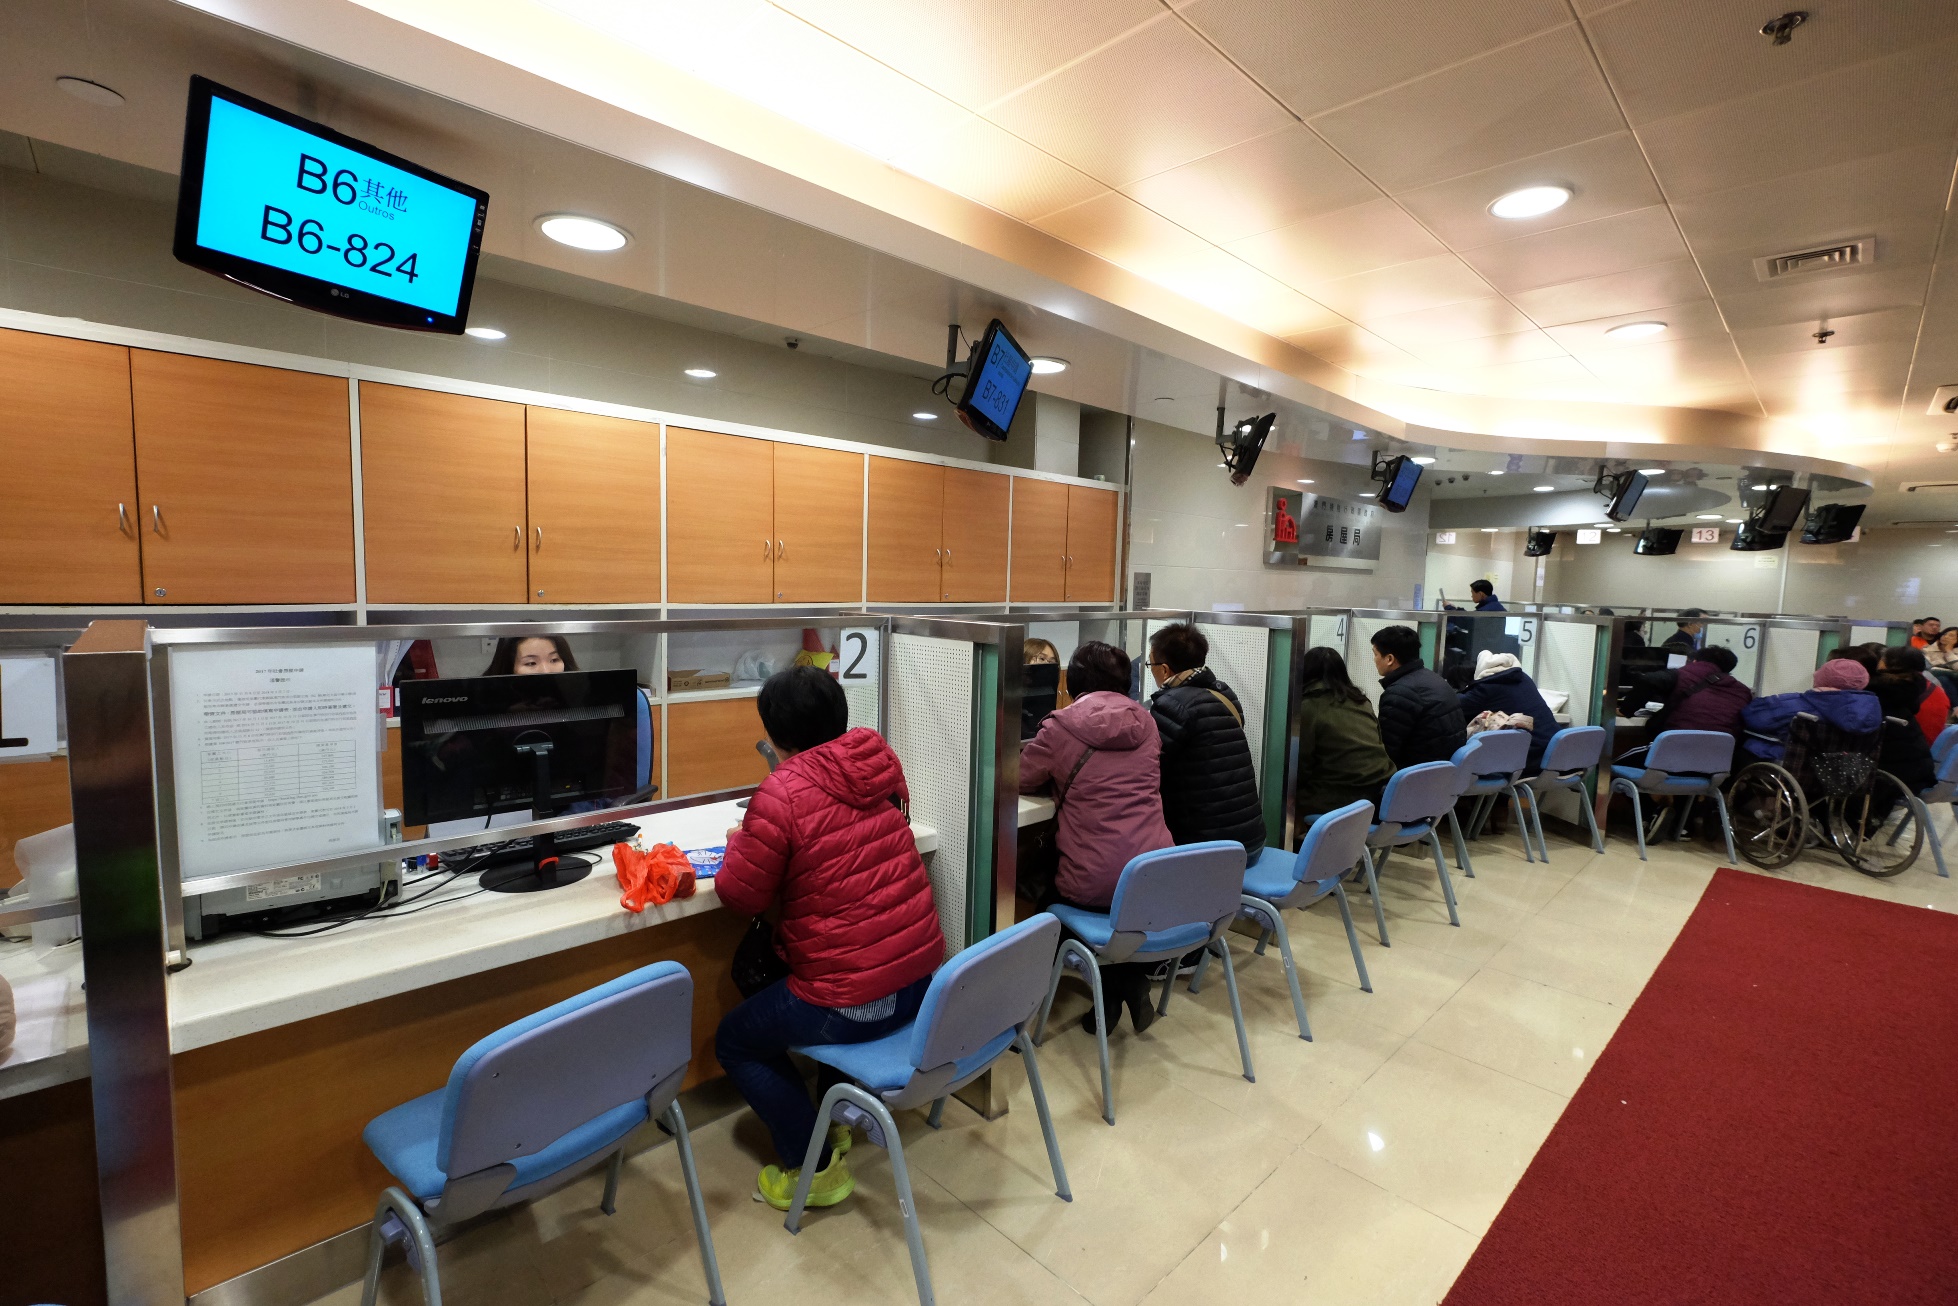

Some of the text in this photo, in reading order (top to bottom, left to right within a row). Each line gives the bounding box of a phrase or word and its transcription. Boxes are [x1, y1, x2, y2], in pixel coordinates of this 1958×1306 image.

[296, 153, 408, 213] B6 其他
[358, 199, 395, 221] Outros
[260, 203, 419, 284] B6-824
[990, 343, 1005, 368] B7
[1695, 529, 1715, 542] 13
[1336, 617, 1344, 642] 4
[1521, 620, 1533, 643] 5
[1743, 627, 1757, 649] 6
[843, 632, 867, 679] 2
[421, 696, 469, 704] lenovo
